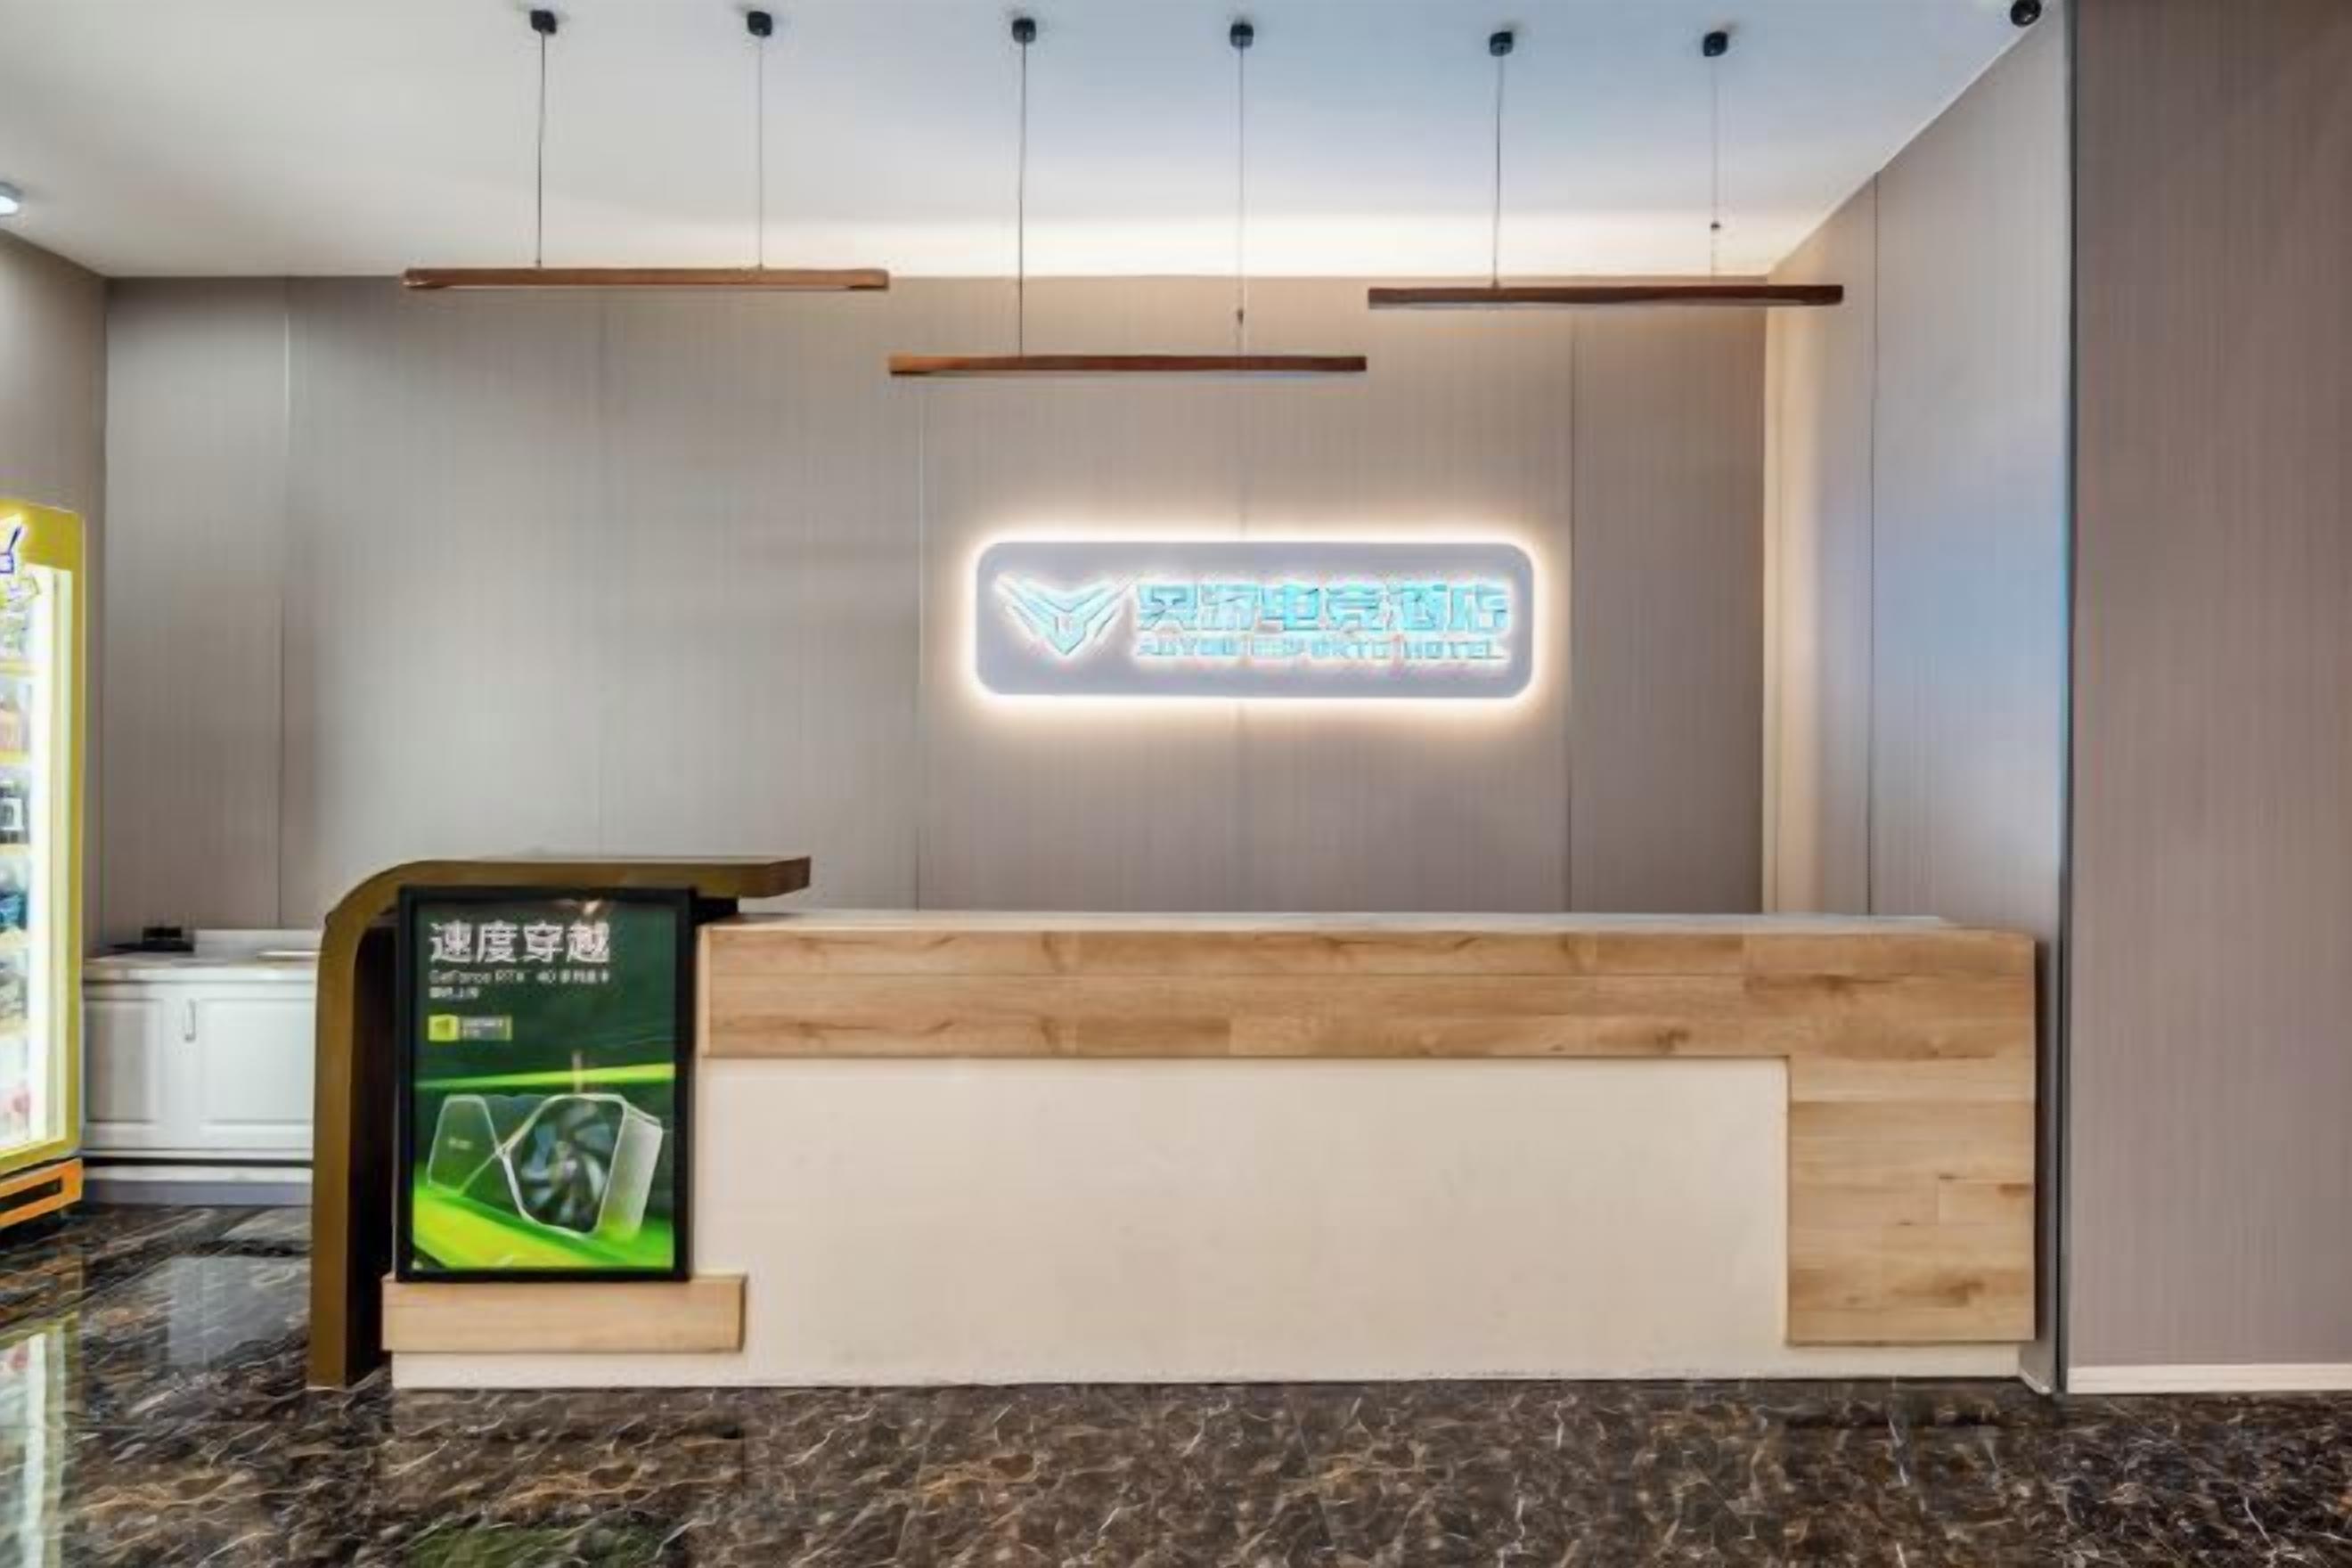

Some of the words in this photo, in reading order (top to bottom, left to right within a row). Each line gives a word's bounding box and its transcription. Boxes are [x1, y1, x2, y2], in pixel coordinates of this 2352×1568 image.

[1402, 640, 1506, 659] HOTEL
[429, 920, 610, 963] 速度穿越
